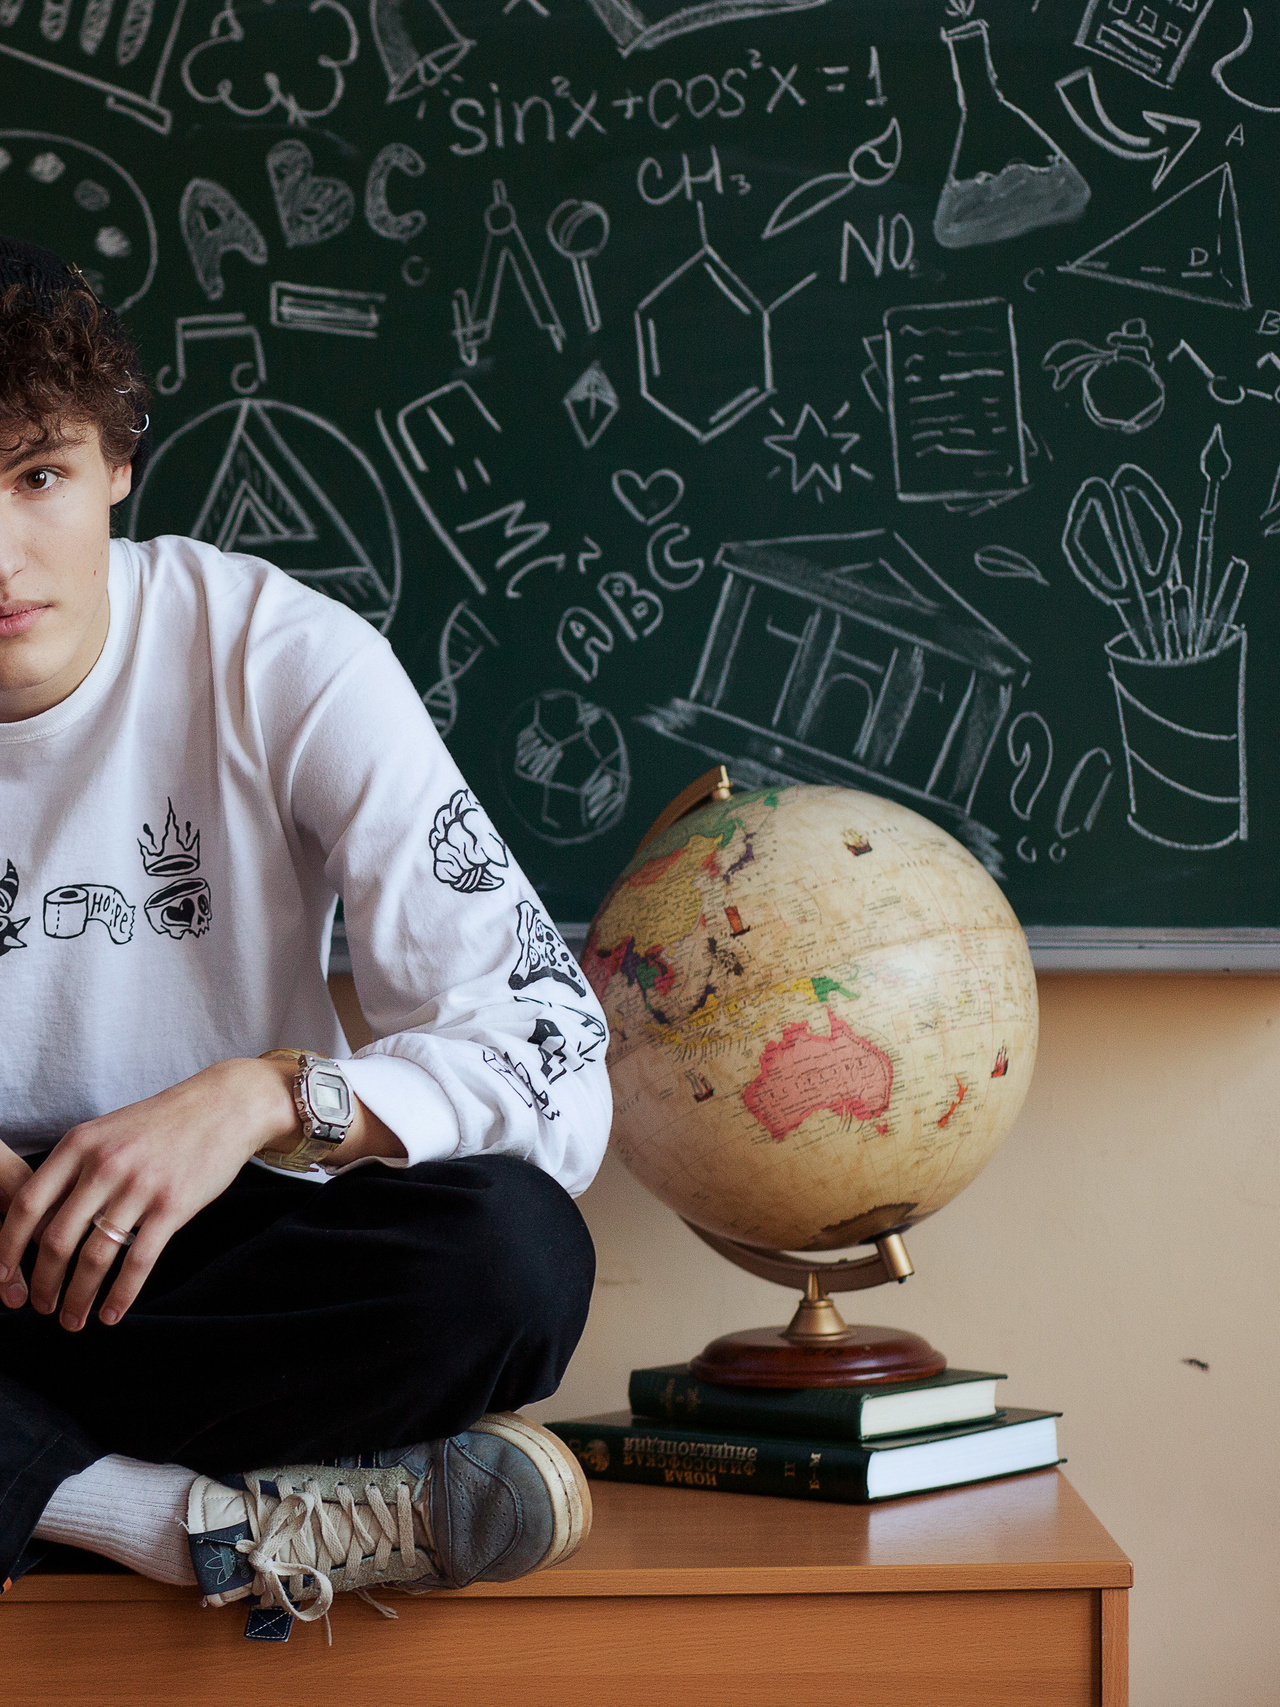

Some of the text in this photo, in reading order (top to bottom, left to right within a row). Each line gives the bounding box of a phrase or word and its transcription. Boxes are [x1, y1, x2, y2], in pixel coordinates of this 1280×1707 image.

[1189, 246, 1209, 267] D
[622, 1436, 758, 1462] ЭНЦИКЛОПЕДИЯ
[622, 1451, 757, 1476] ФИЛОСОФСКАЯ
[663, 1468, 718, 1487] НОВАЯ
